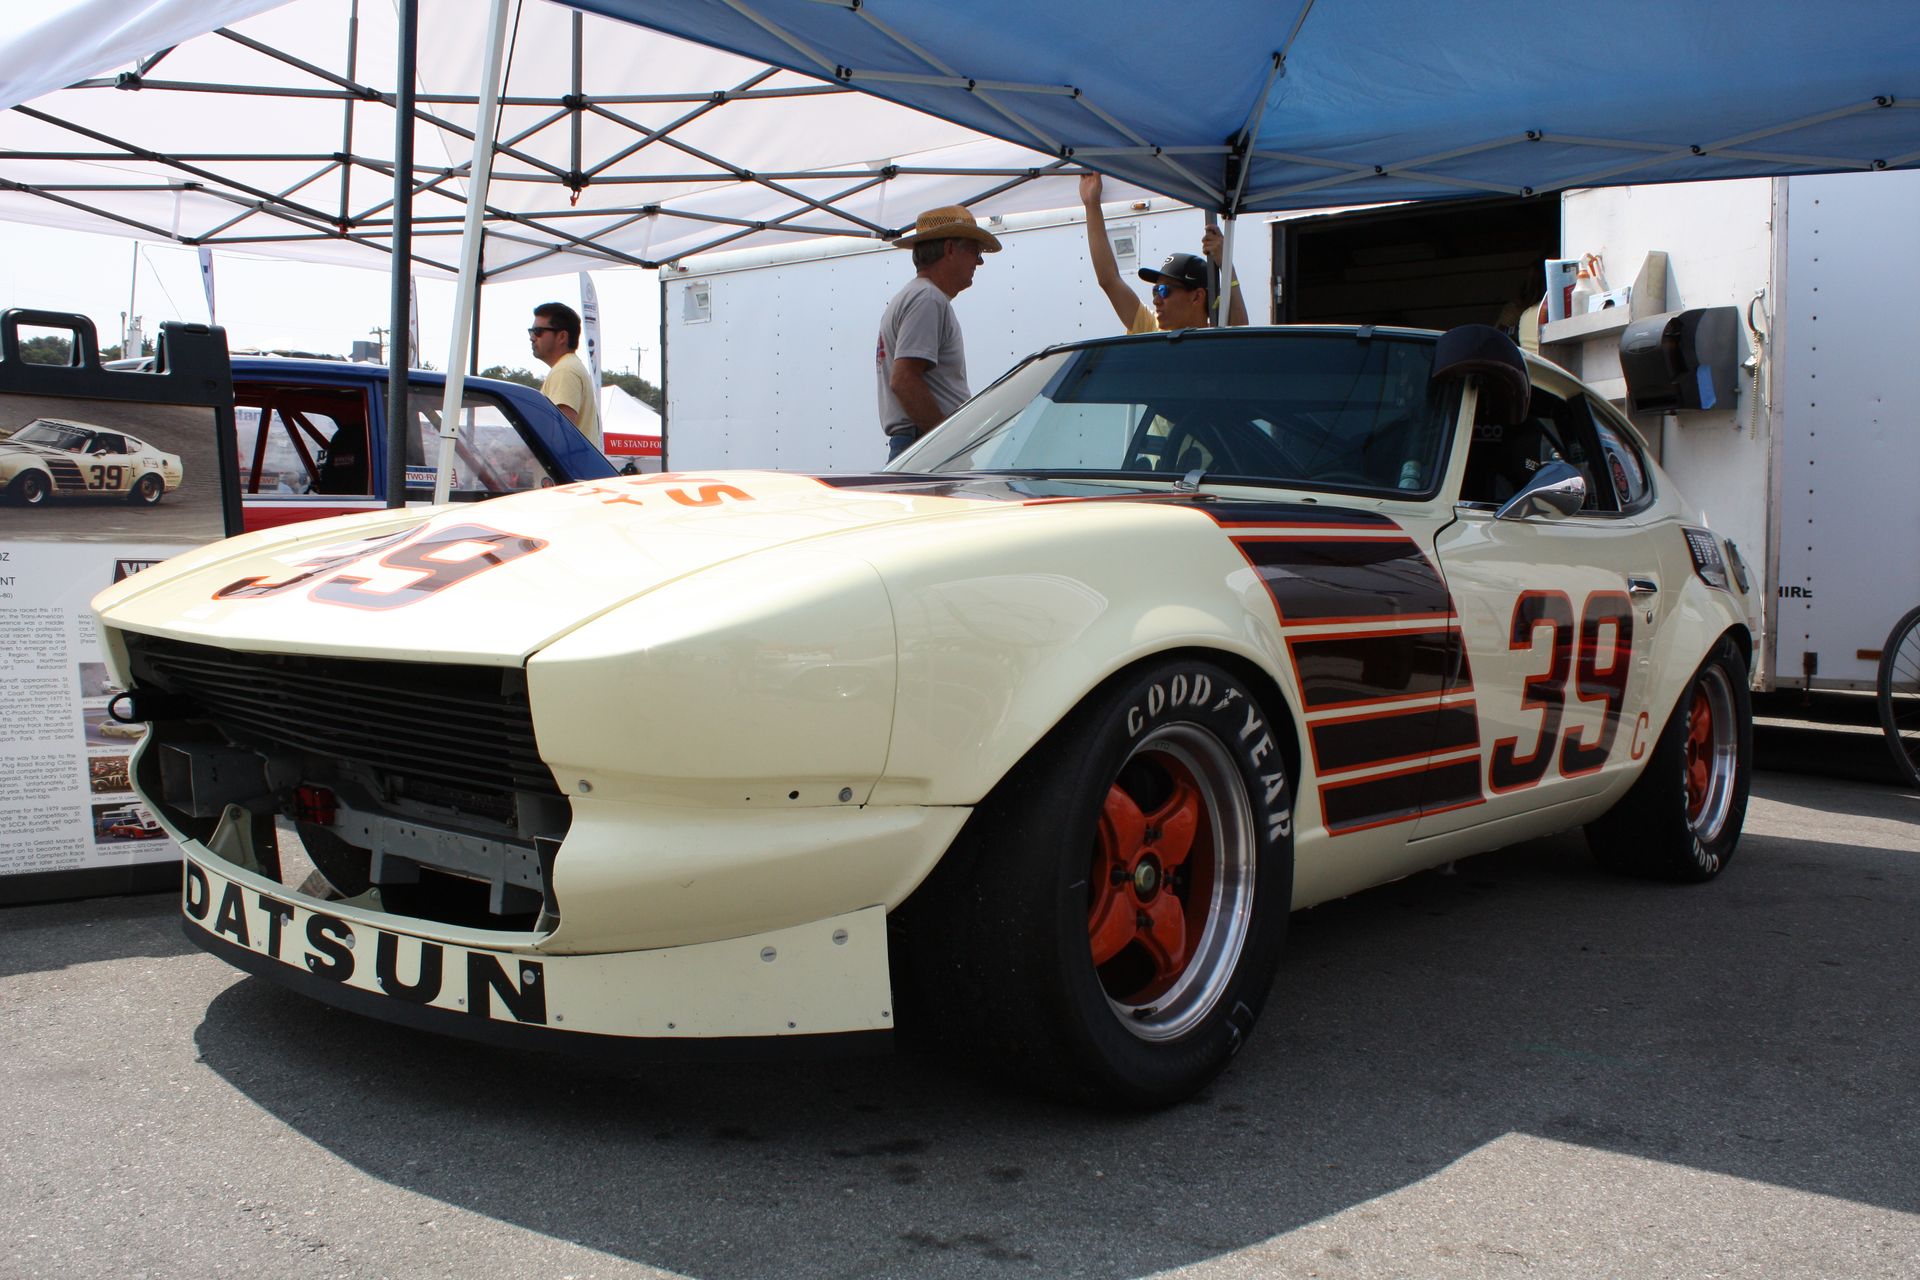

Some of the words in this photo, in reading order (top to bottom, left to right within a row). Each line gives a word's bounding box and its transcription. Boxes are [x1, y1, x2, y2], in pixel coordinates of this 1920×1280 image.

[610, 439, 622, 448] WE
[623, 440, 648, 448] STAND
[90, 465, 123, 490] 39
[1489, 589, 1633, 795] 39
[1632, 711, 1648, 761] C
[185, 860, 547, 1026] DATSUN
